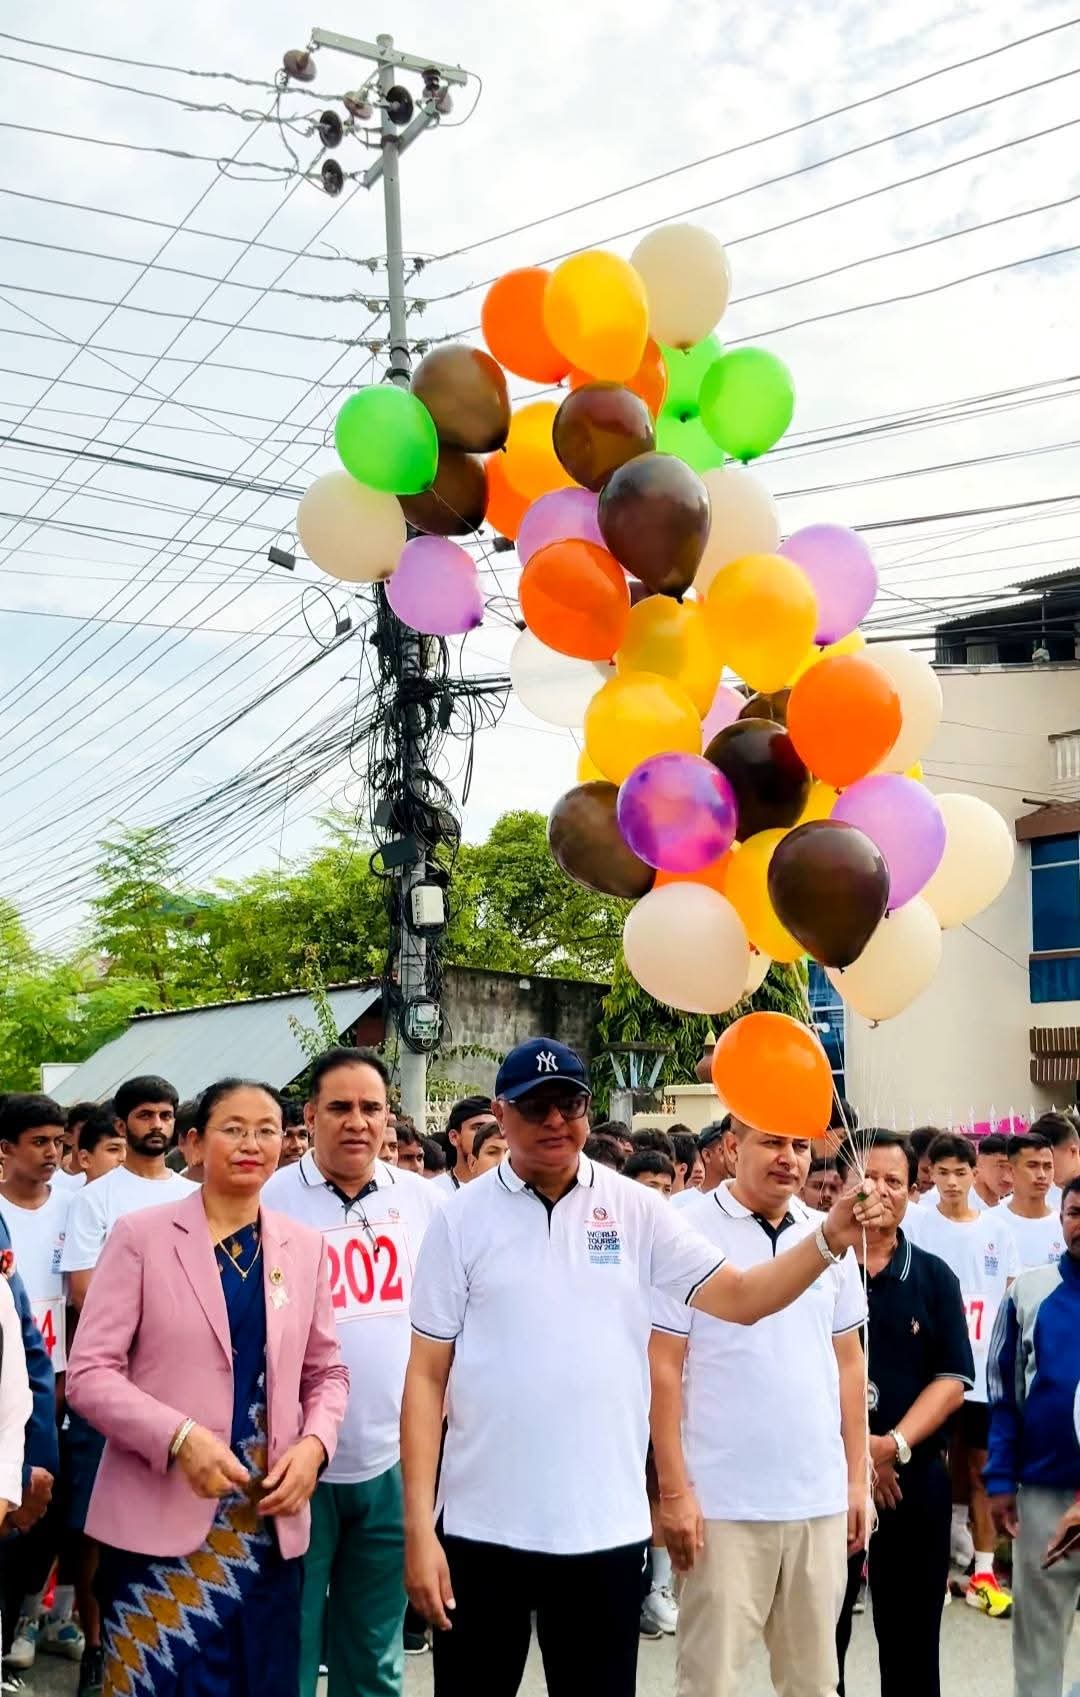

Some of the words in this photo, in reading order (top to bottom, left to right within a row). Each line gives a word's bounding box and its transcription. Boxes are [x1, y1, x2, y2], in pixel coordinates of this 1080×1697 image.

[536, 1051, 558, 1072] NY
[587, 1230, 618, 1238] WORLD
[327, 1236, 403, 1308] 202
[32, 1309, 56, 1357] 4
[962, 1301, 984, 1340] 7
